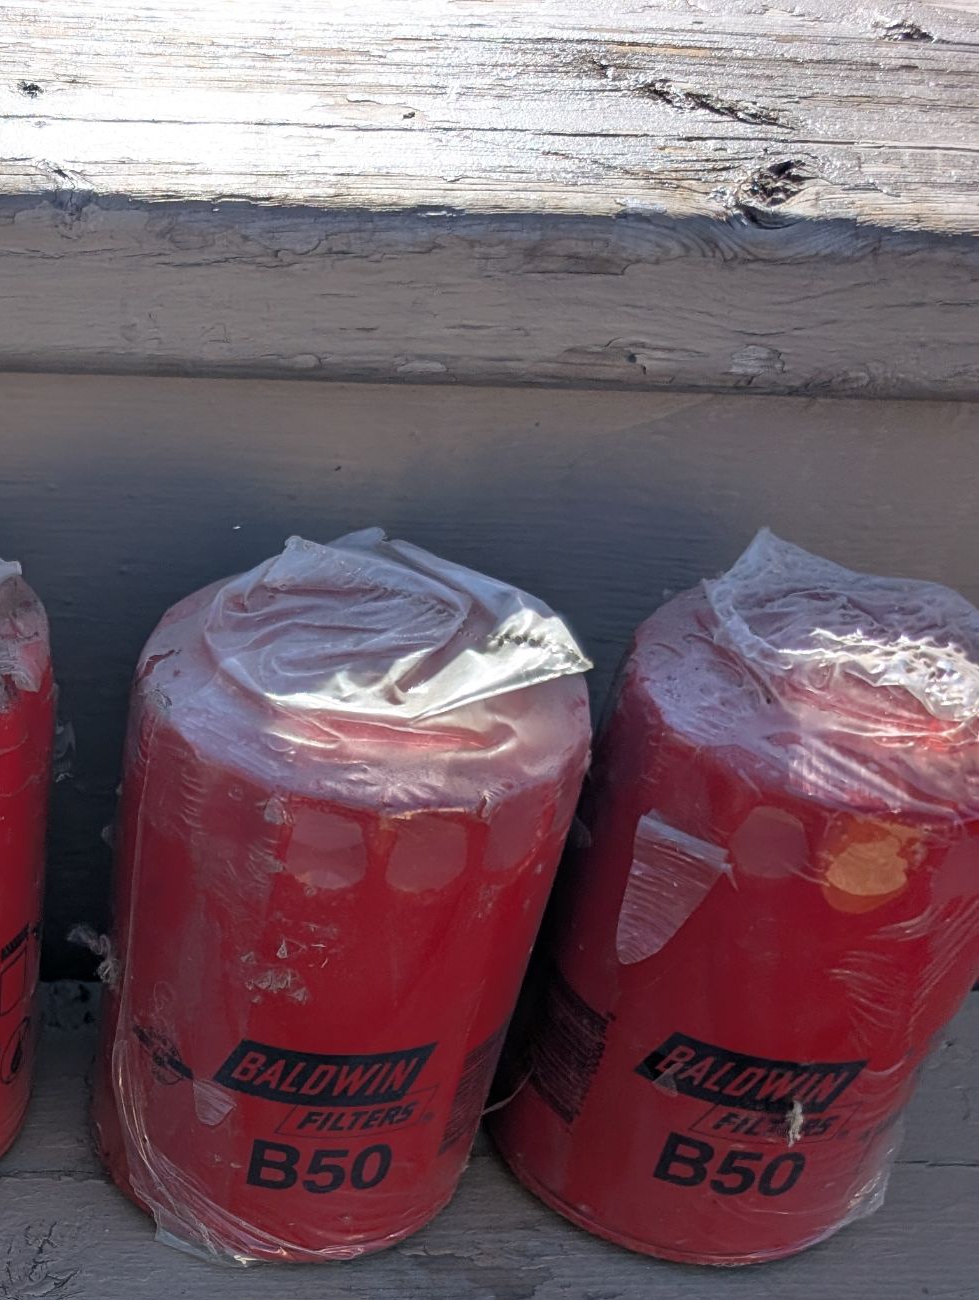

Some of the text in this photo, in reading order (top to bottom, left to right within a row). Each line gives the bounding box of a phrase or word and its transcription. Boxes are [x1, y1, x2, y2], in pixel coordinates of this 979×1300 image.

[233, 1051, 419, 1098] BALDWIN
[658, 1045, 848, 1104] BALDWIN
[297, 1102, 417, 1131] FILTERS
[712, 1111, 839, 1139] FILRS
[246, 1138, 392, 1194] B50
[653, 1131, 806, 1196] B50
